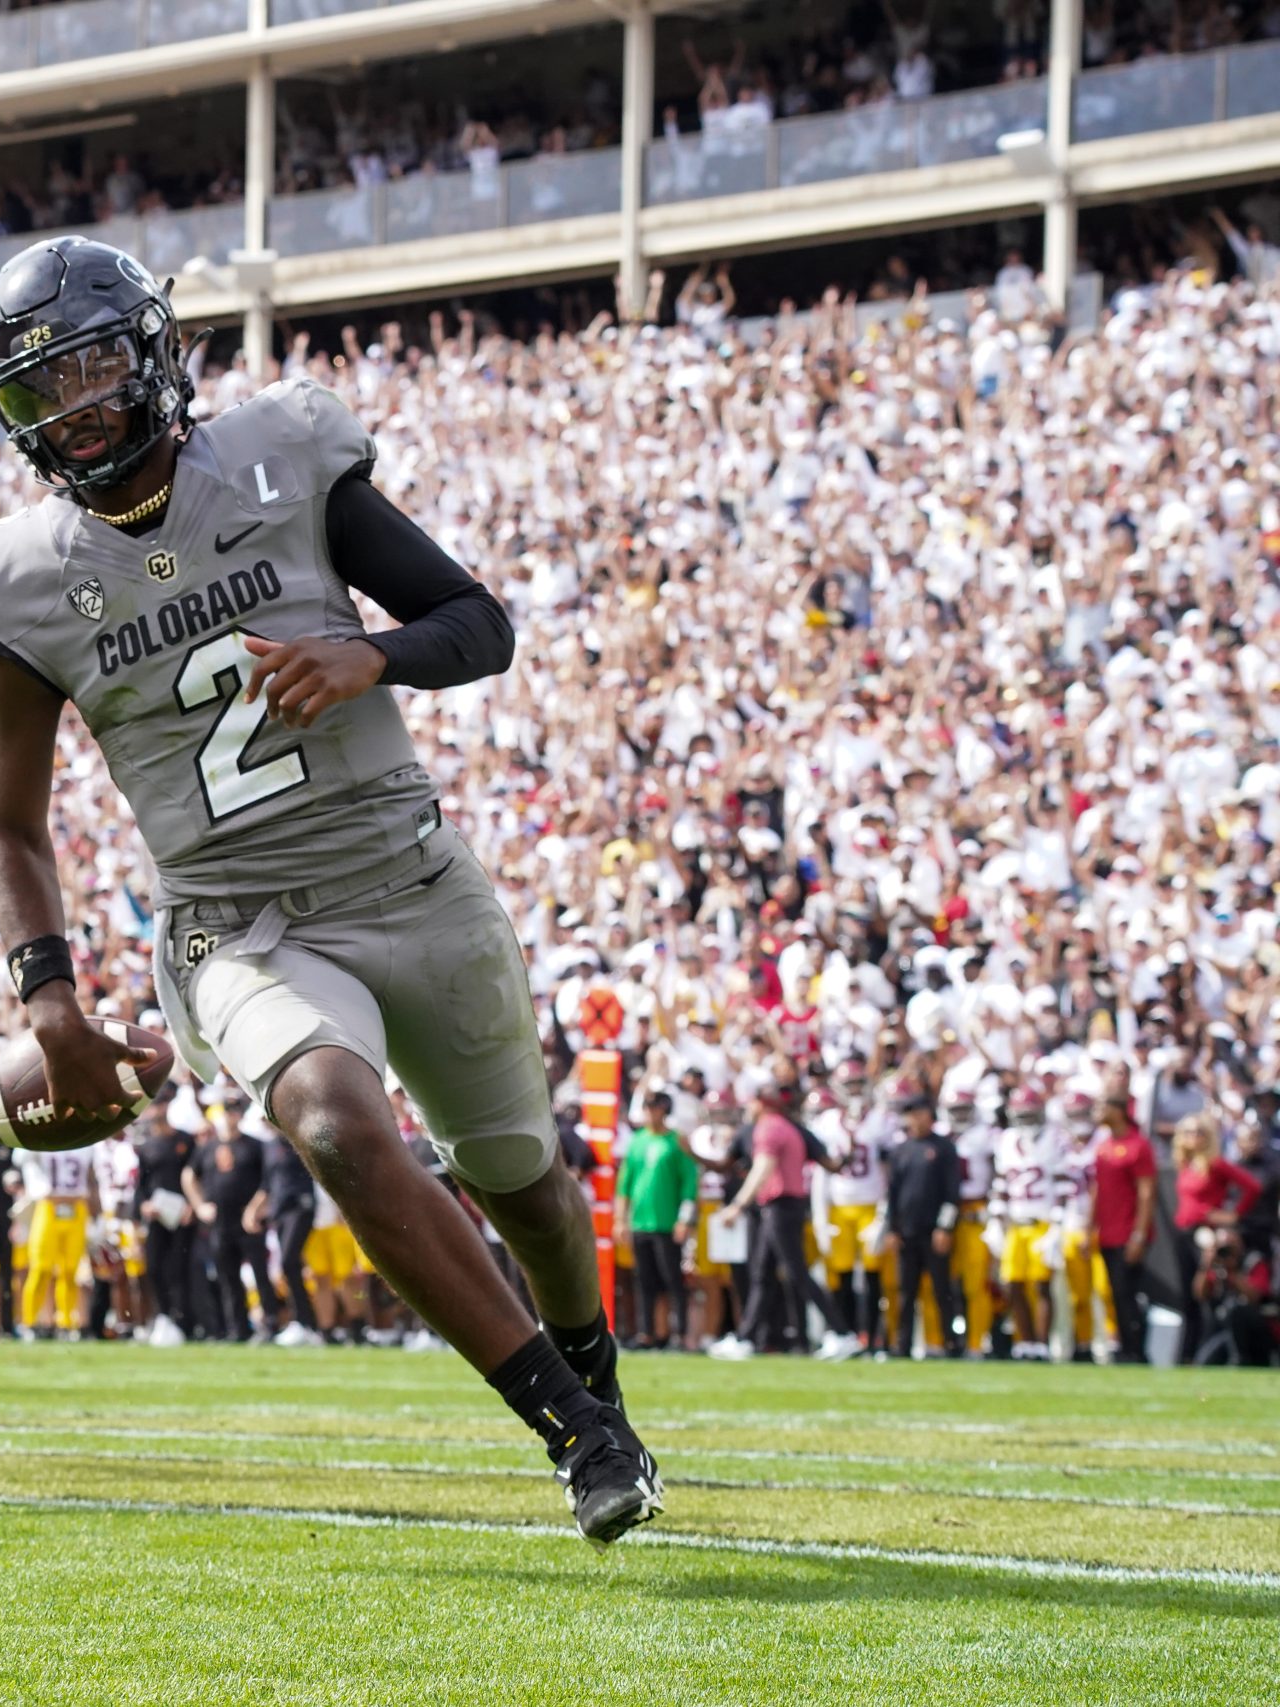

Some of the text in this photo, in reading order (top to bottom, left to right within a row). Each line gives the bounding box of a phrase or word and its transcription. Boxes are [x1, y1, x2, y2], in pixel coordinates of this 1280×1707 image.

[253, 462, 280, 504] L
[147, 551, 177, 581] CU
[96, 559, 283, 677] COLORADO
[171, 625, 311, 826] 2
